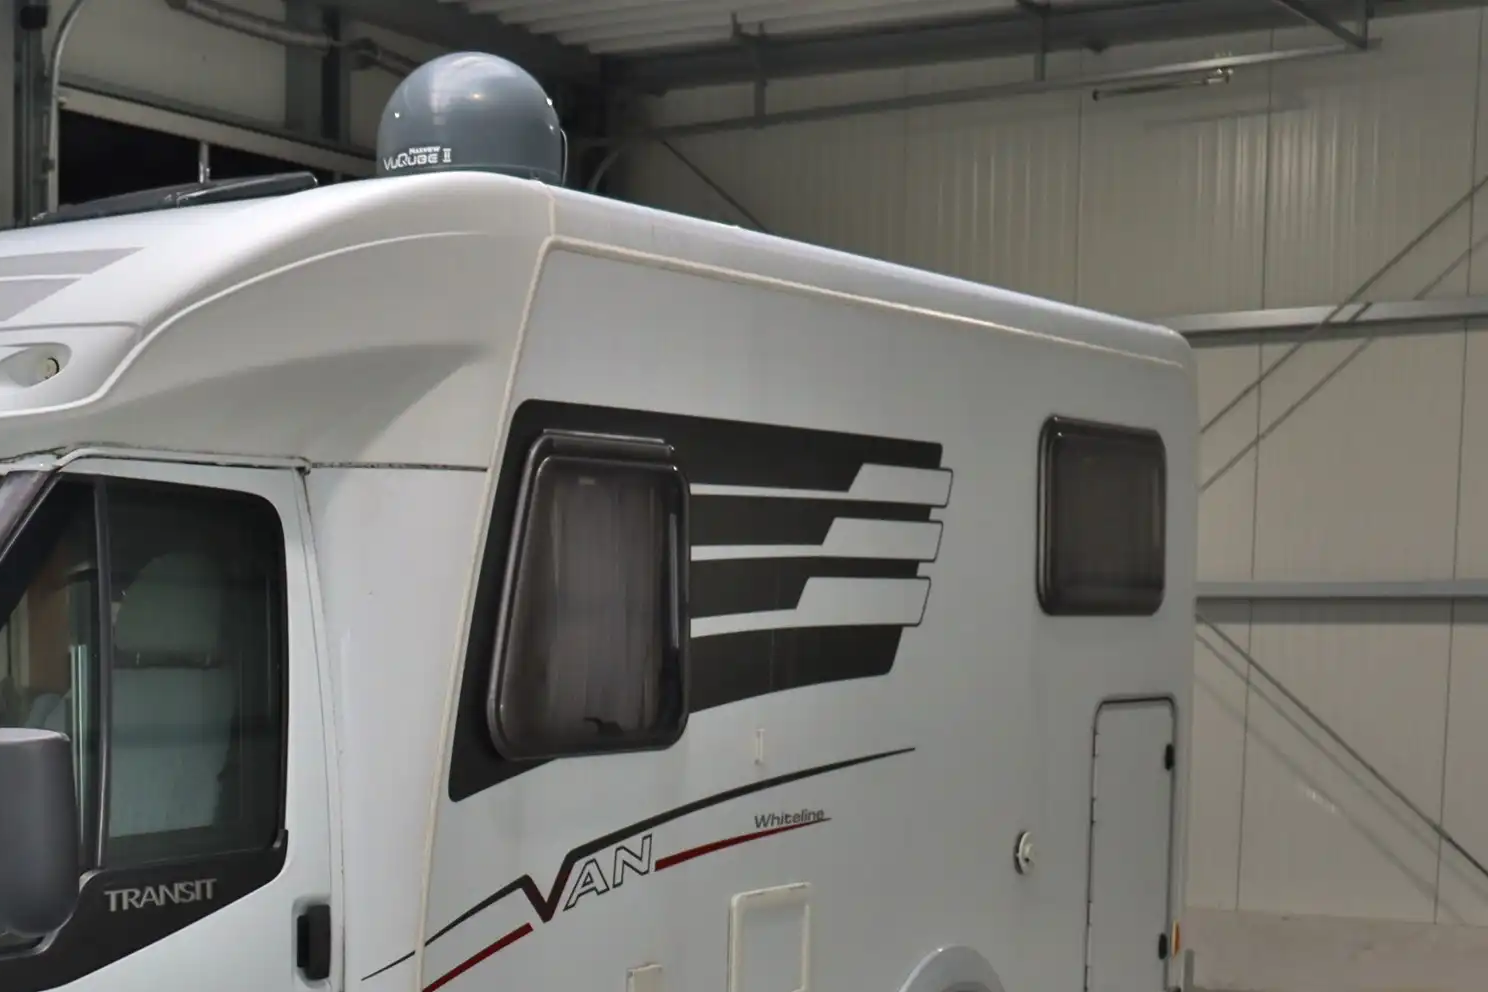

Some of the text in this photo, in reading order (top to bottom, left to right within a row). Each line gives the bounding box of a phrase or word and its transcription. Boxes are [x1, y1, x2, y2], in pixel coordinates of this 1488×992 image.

[754, 808, 825, 829] Whiteline
[103, 878, 218, 912] TRANSIT
[520, 833, 653, 923] VAN
